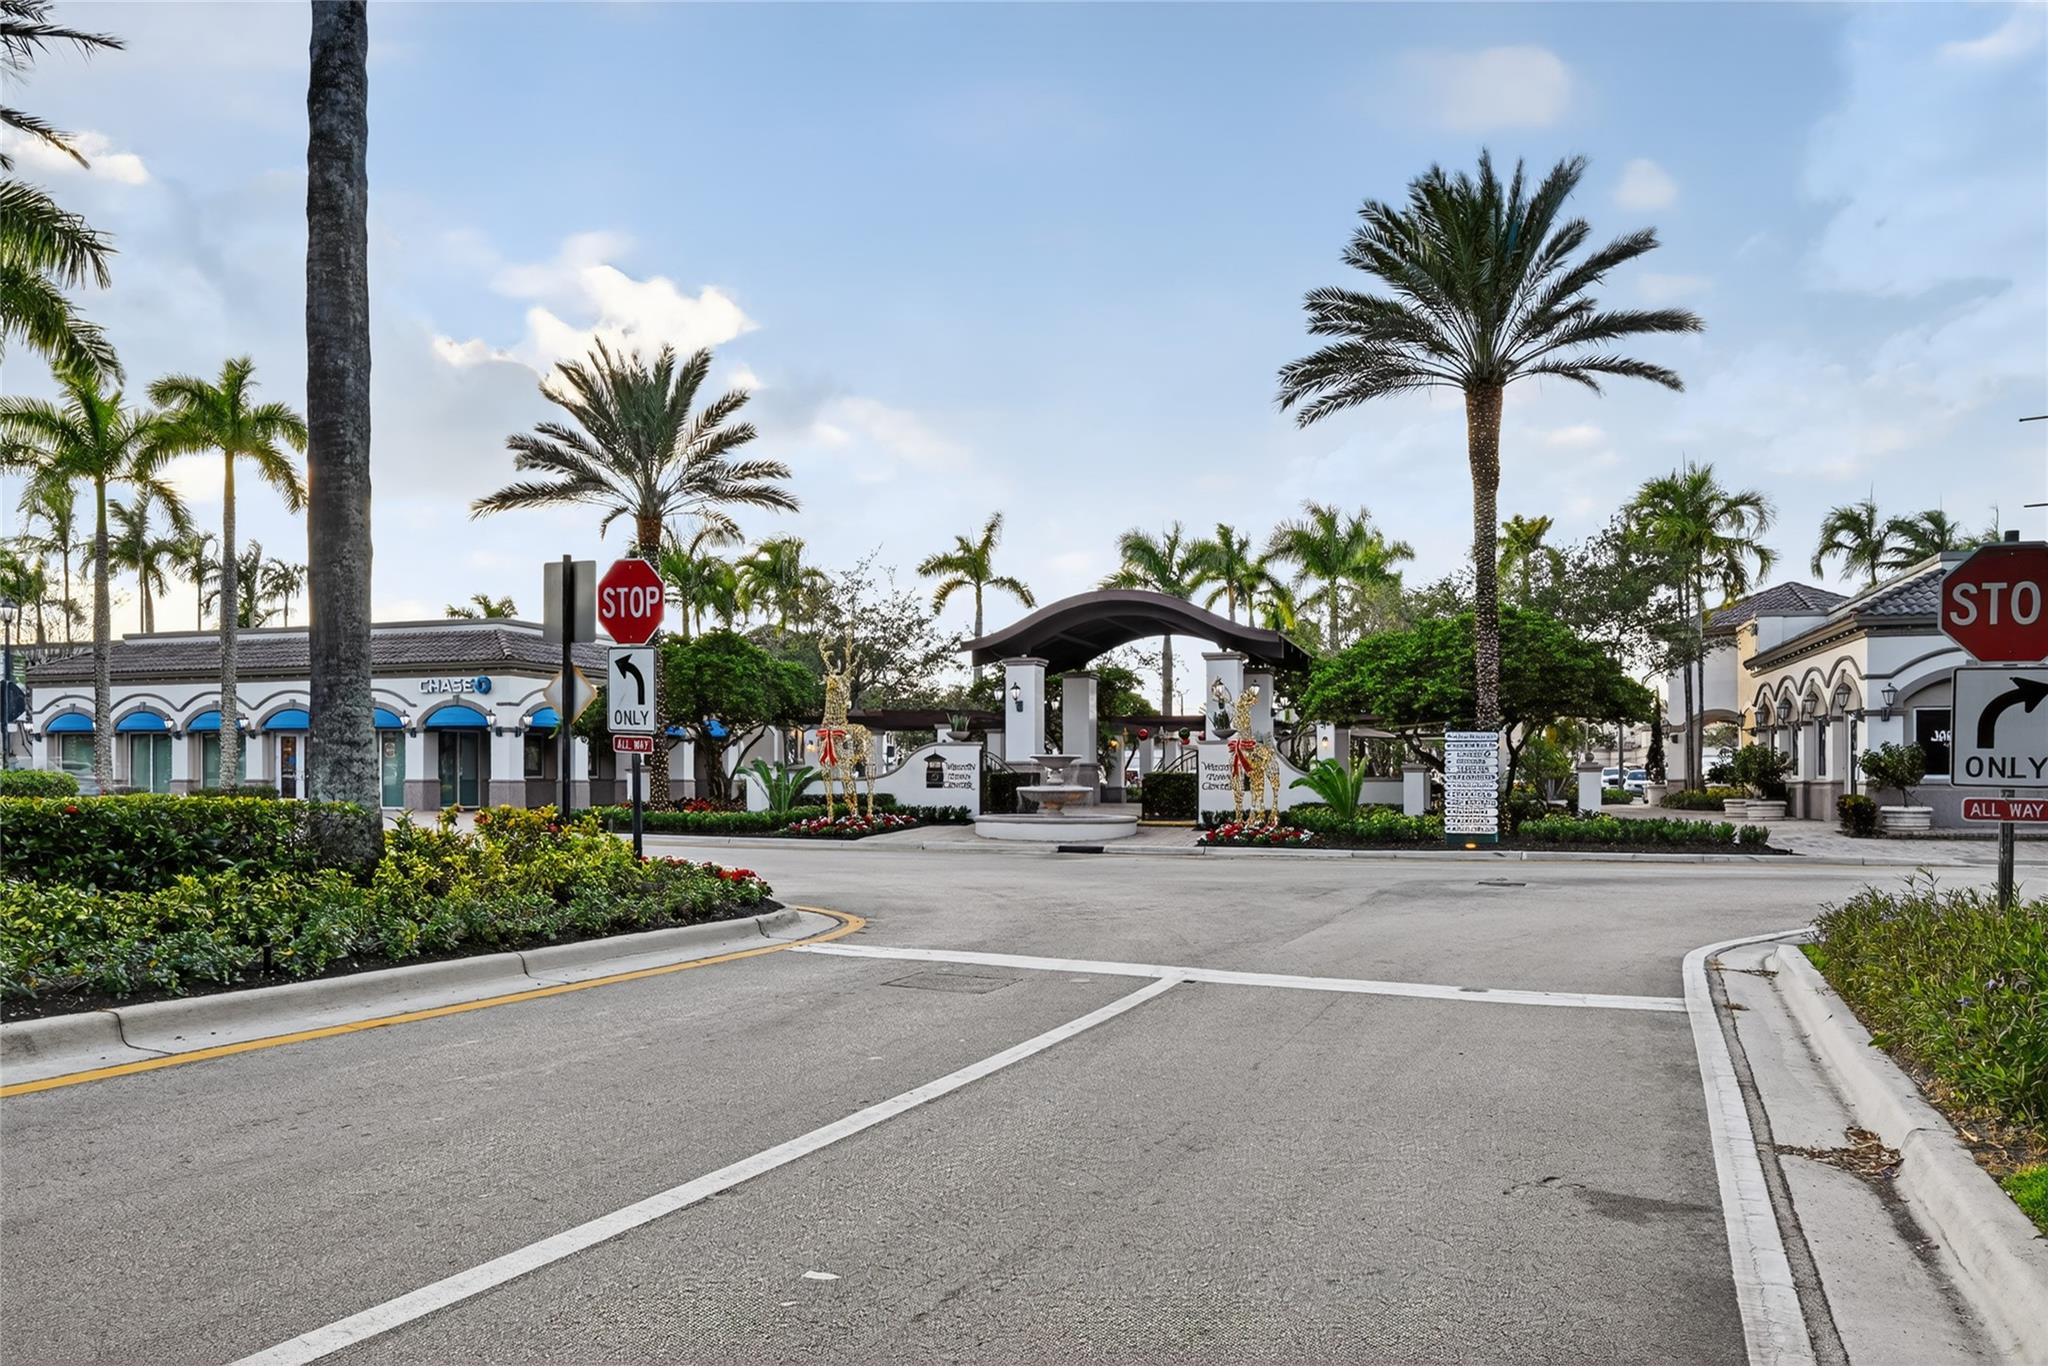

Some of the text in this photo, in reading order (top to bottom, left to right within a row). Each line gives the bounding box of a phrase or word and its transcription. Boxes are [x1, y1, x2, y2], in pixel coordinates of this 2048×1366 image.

[602, 586, 660, 618] STOP
[1949, 581, 2042, 626] STO
[419, 679, 474, 693] CHASE
[614, 709, 649, 725] ONLY
[617, 738, 649, 751] ALL WAY
[1965, 756, 2048, 779] ONLY
[1970, 802, 2044, 818] ALL WAY
